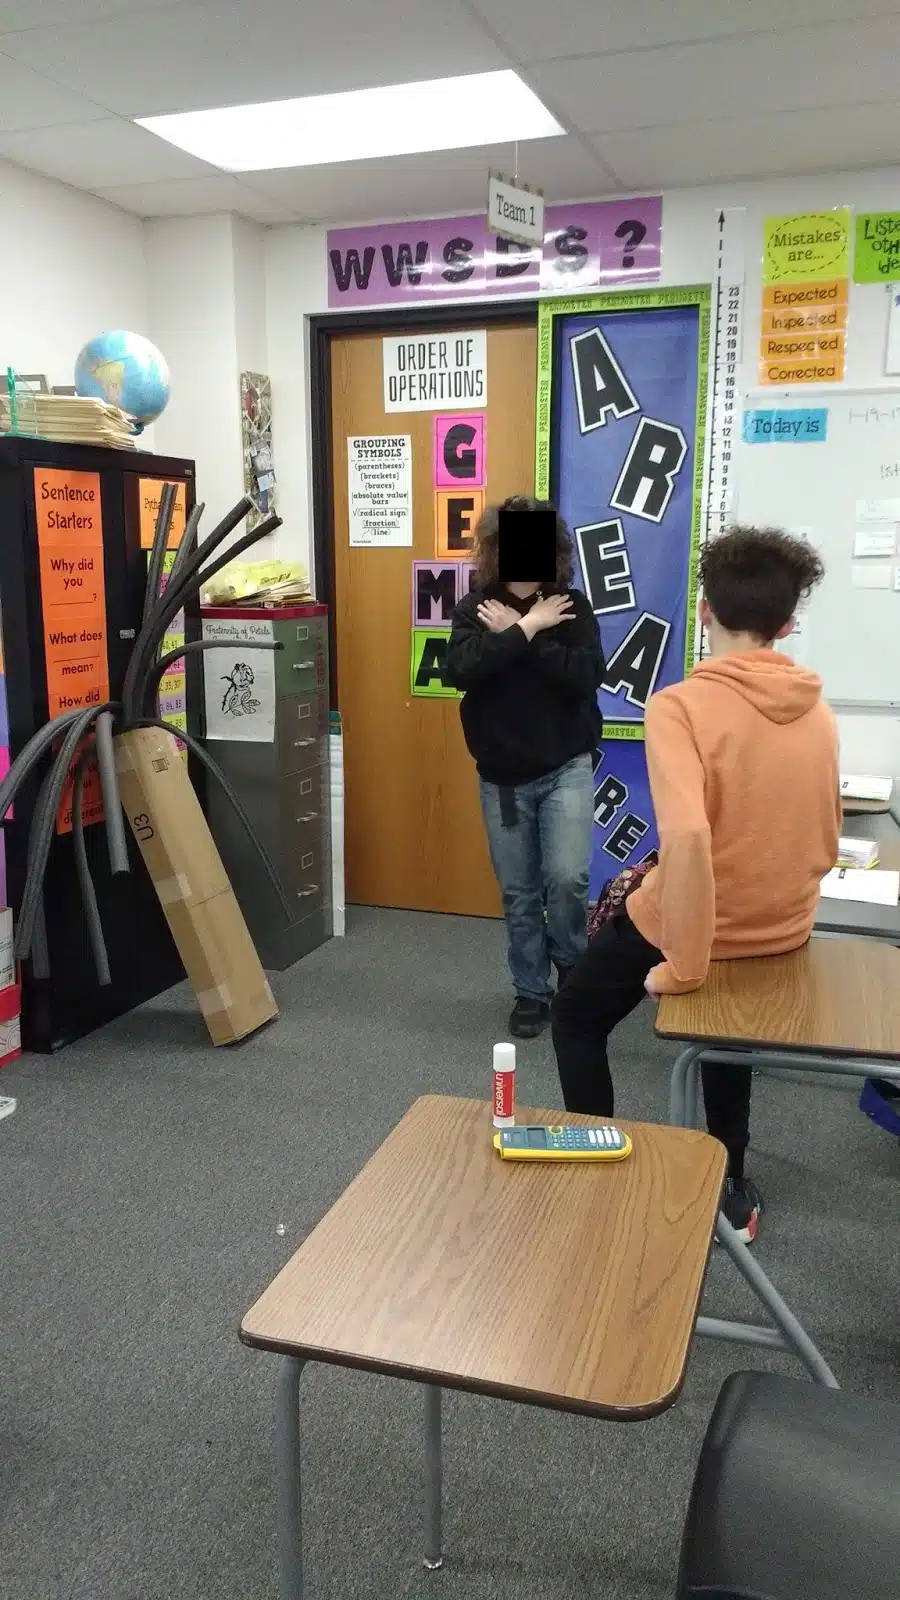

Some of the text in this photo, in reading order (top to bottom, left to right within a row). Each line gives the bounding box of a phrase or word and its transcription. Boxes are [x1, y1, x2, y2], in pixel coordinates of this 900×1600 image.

[496, 192, 535, 226] Team 1
[774, 230, 840, 247] Mistakes
[787, 249, 824, 262] are...
[728, 287, 740, 296] 23
[773, 285, 838, 305] Expected
[728, 300, 739, 310] 22
[728, 313, 738, 322] 21
[772, 311, 837, 330] Inspected
[726, 326, 738, 336] 20
[727, 339, 736, 349] 19
[398, 339, 474, 371] ORDER OF
[726, 352, 736, 362] 18
[728, 364, 735, 374] 17
[767, 366, 835, 381] Corrected
[388, 369, 483, 402] OPERATIONS
[726, 377, 735, 387] 16
[725, 389, 734, 400] 15
[725, 402, 734, 412] 14
[722, 428, 732, 437] 12
[752, 418, 819, 438] Today is
[353, 438, 405, 449] GROUPING
[724, 440, 731, 448] 11
[358, 448, 402, 458] SYMBOLS
[443, 423, 476, 479] G
[722, 452, 731, 462] 10
[354, 462, 405, 472] (parentheses)
[538, 441, 548, 492] PERIMETER
[723, 465, 728, 474] 9
[360, 472, 400, 481] [brackets]
[722, 477, 728, 486] 8
[42, 482, 95, 502] Sentence
[722, 490, 726, 499] 7
[720, 502, 726, 511] 6
[48, 511, 93, 530] Starters
[720, 514, 726, 522] 5
[50, 558, 94, 575] Why did
[64, 578, 83, 590] you
[50, 630, 102, 645] What does
[62, 663, 94, 676] mean?
[60, 690, 100, 708] How did
[494, 1073, 506, 1116] universal
